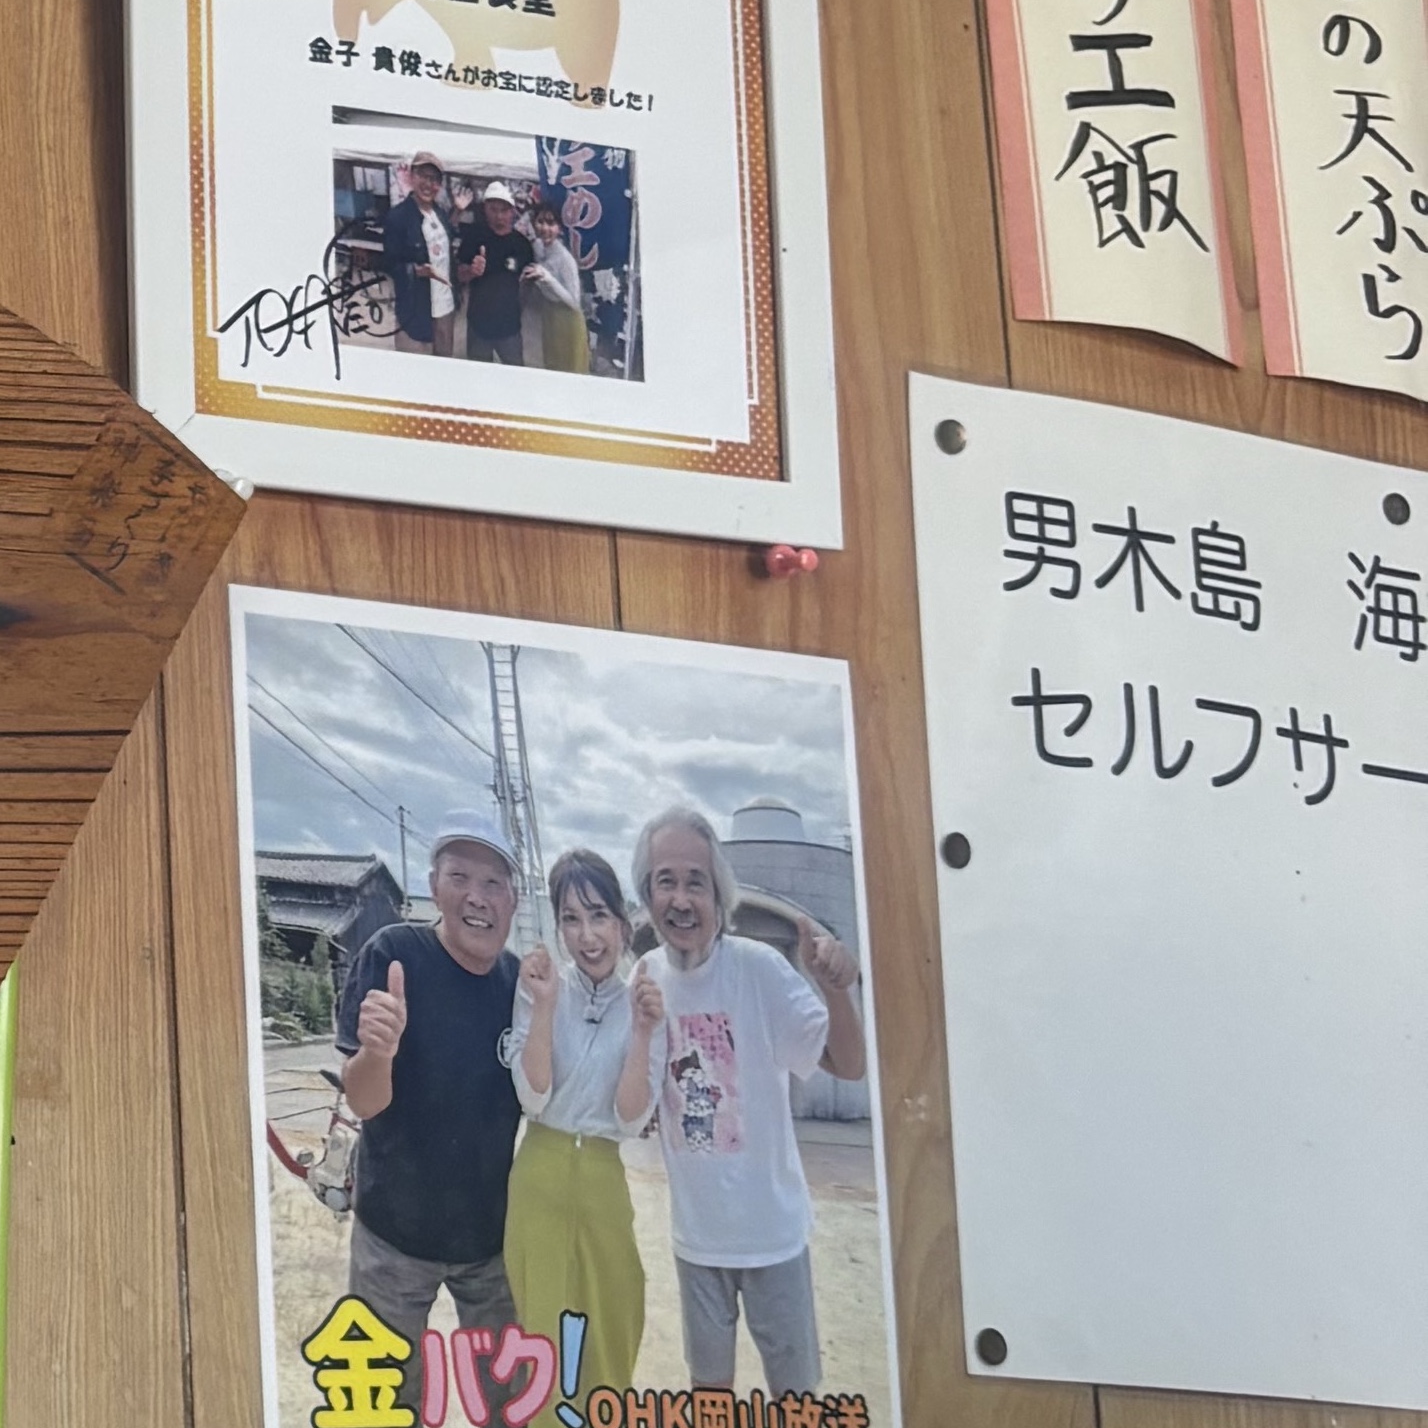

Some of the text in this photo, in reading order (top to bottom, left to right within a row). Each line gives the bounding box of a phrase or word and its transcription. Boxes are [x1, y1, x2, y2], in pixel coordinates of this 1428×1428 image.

[308, 36, 361, 67] 金子
[1002, 489, 1428, 663] 男木島 海
[1010, 667, 1428, 807] セルフサー
